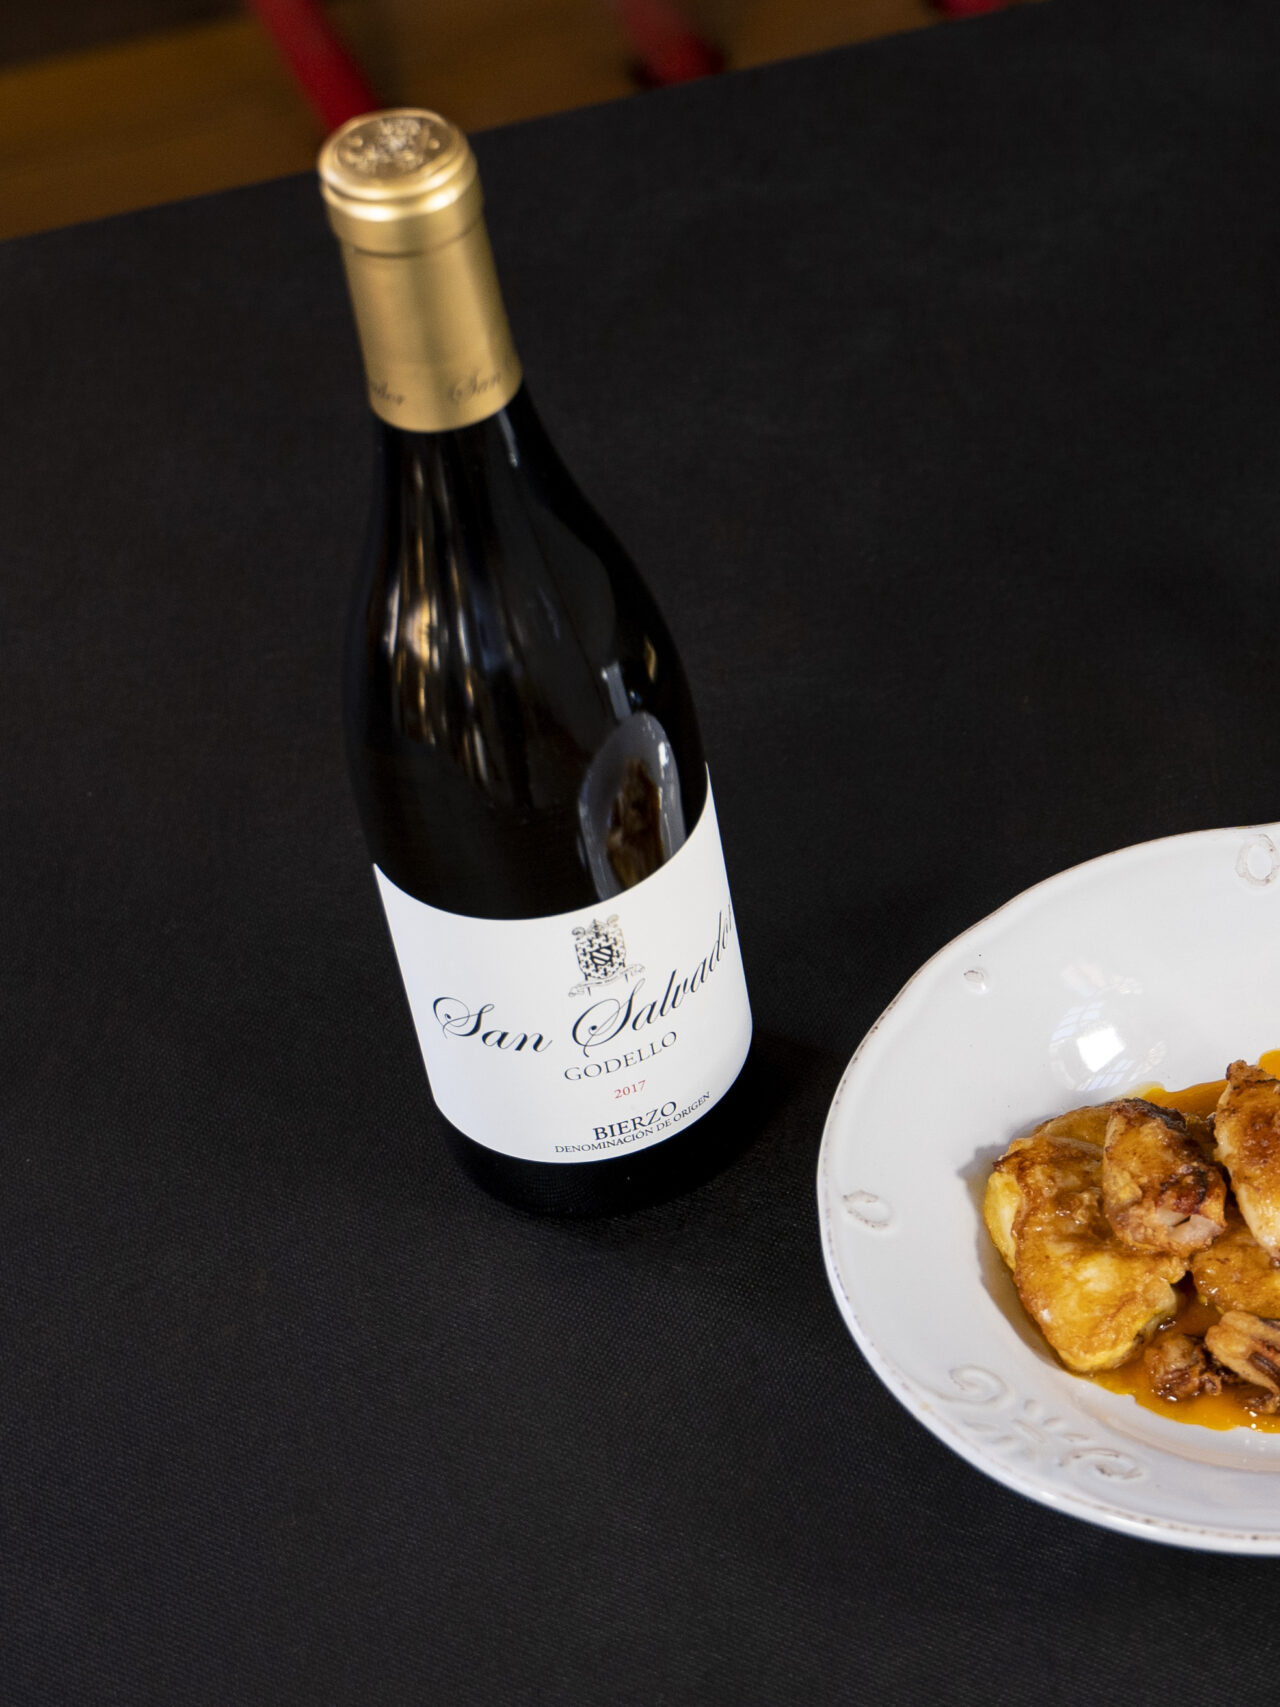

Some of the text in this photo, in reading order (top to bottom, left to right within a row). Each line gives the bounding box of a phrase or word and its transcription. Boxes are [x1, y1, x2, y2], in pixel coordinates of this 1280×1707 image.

[432, 996, 553, 1054] San
[563, 1031, 678, 1081] GODELLO
[614, 1079, 646, 1099] 2017
[554, 1091, 711, 1154] DENOMINACIÓN DE ORIGEN
[592, 1100, 678, 1141] BIERZO
